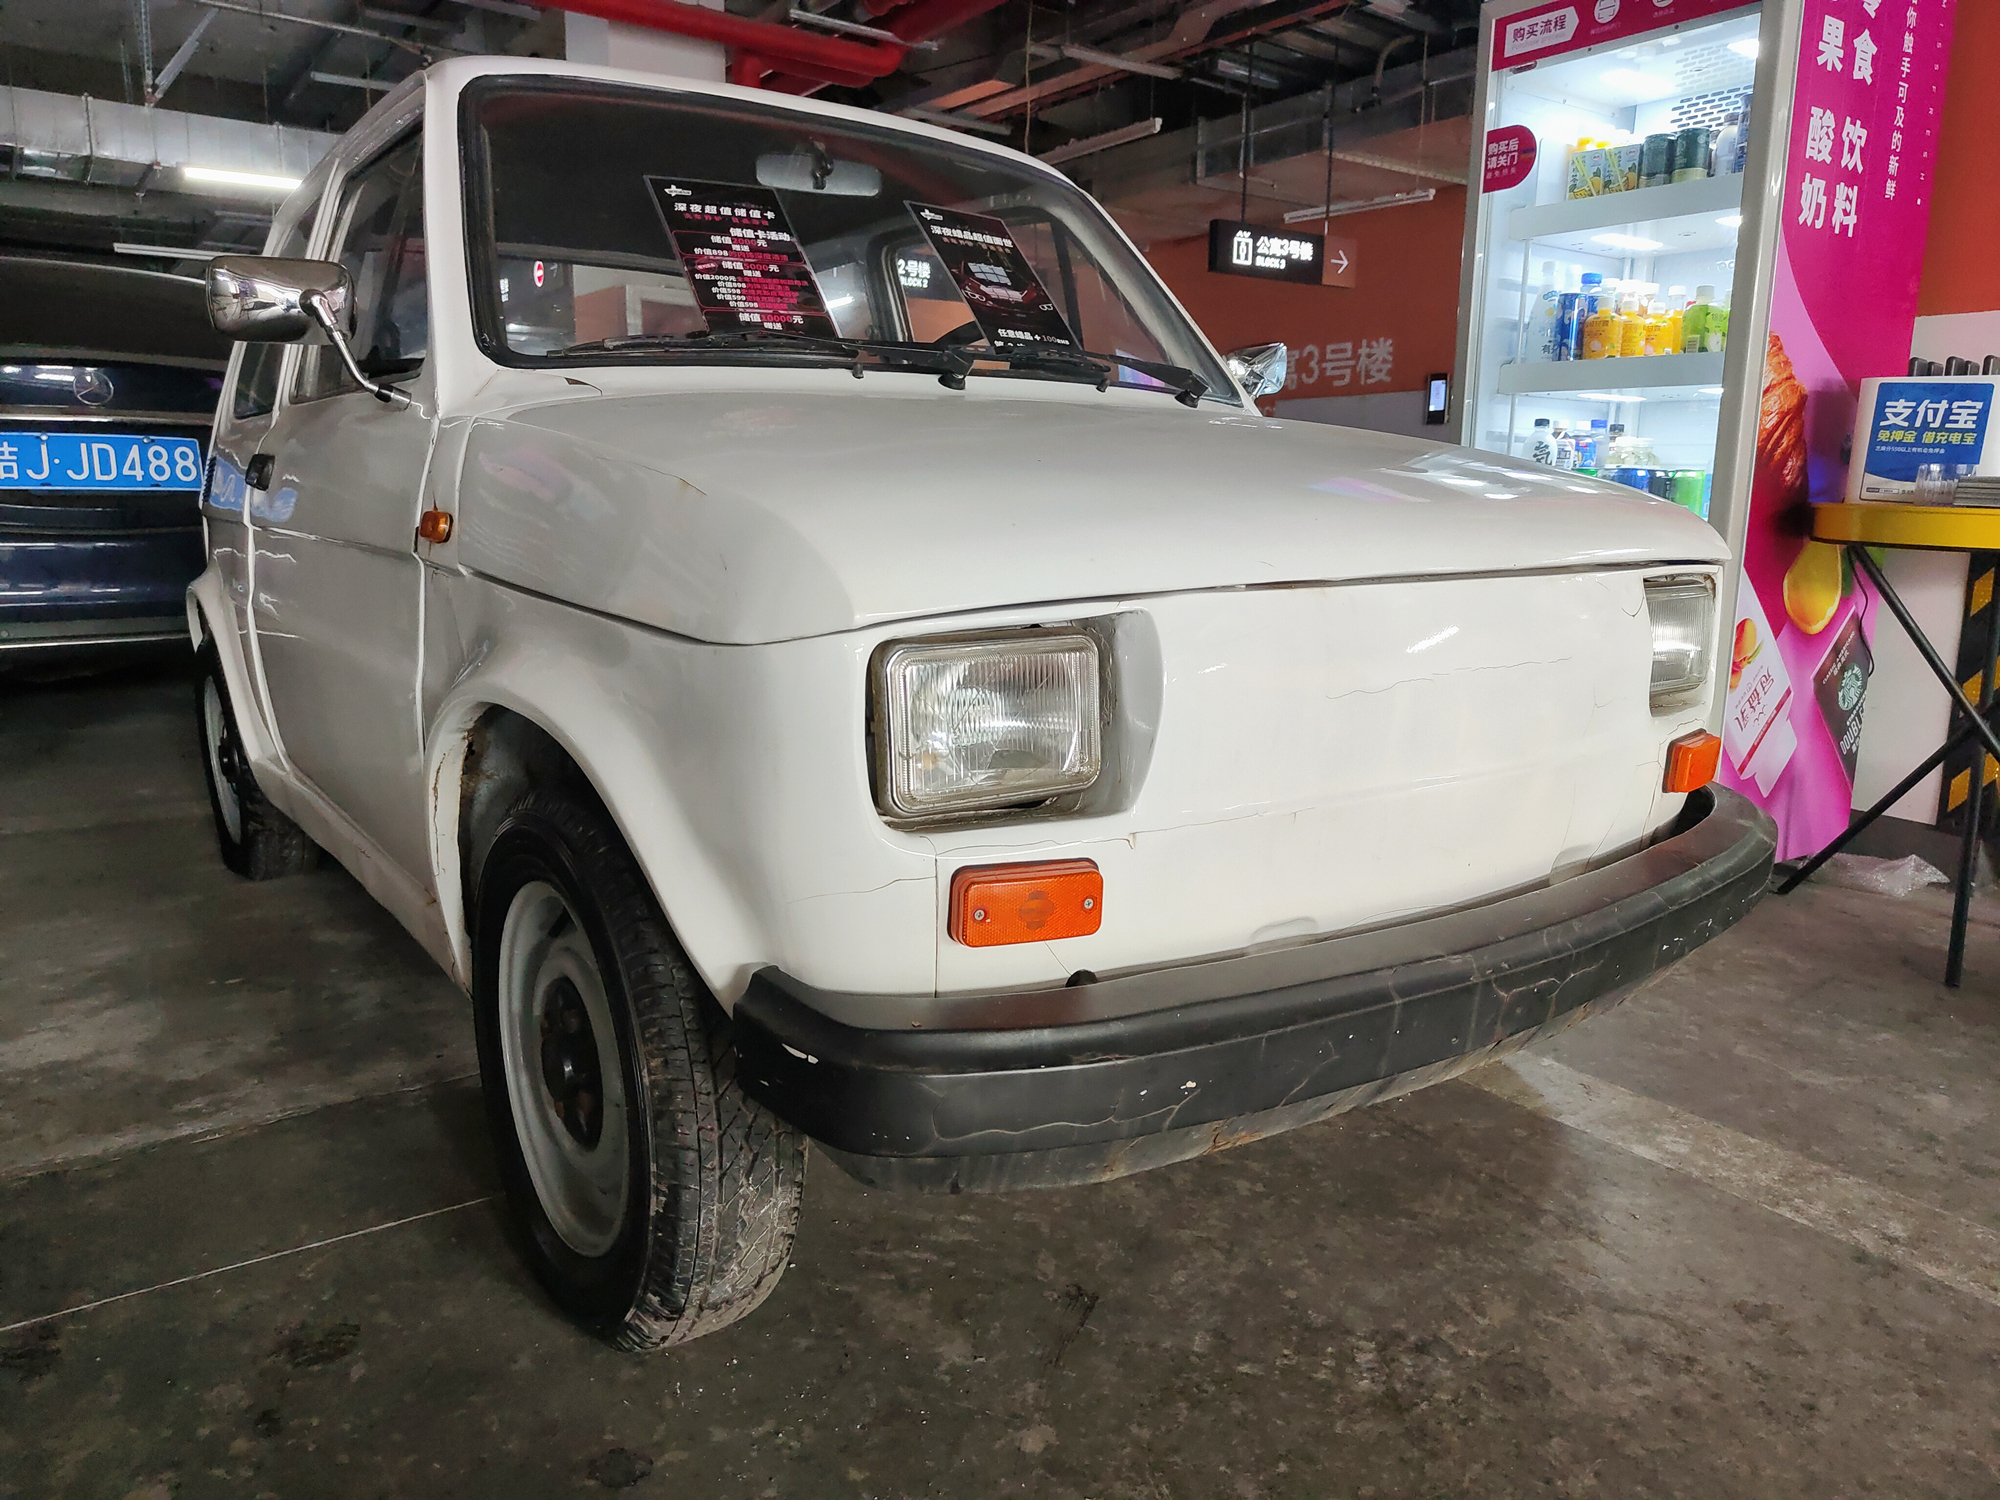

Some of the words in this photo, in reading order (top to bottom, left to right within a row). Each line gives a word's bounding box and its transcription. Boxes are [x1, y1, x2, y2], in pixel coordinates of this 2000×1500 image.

[1512, 14, 1567, 43] 购买流程
[1487, 138, 1520, 158] 购买后
[1486, 152, 1519, 170] 请关门
[674, 202, 776, 220] 深夜超值储值卡
[711, 235, 768, 248] 储值2000元
[730, 227, 791, 242] 储值卡活动
[1256, 236, 1314, 262] 公寓3号楼
[722, 260, 780, 273] 储值5000元
[897, 258, 931, 279] 2号楼
[1255, 255, 1280, 268] BLOCK
[1279, 259, 1287, 270] 3
[922, 278, 929, 289] 2
[739, 312, 804, 325] 储值10000元
[1879, 399, 1984, 429] 支付宝
[1876, 430, 1918, 443] 免押金
[1921, 431, 1978, 445] 借充电宝
